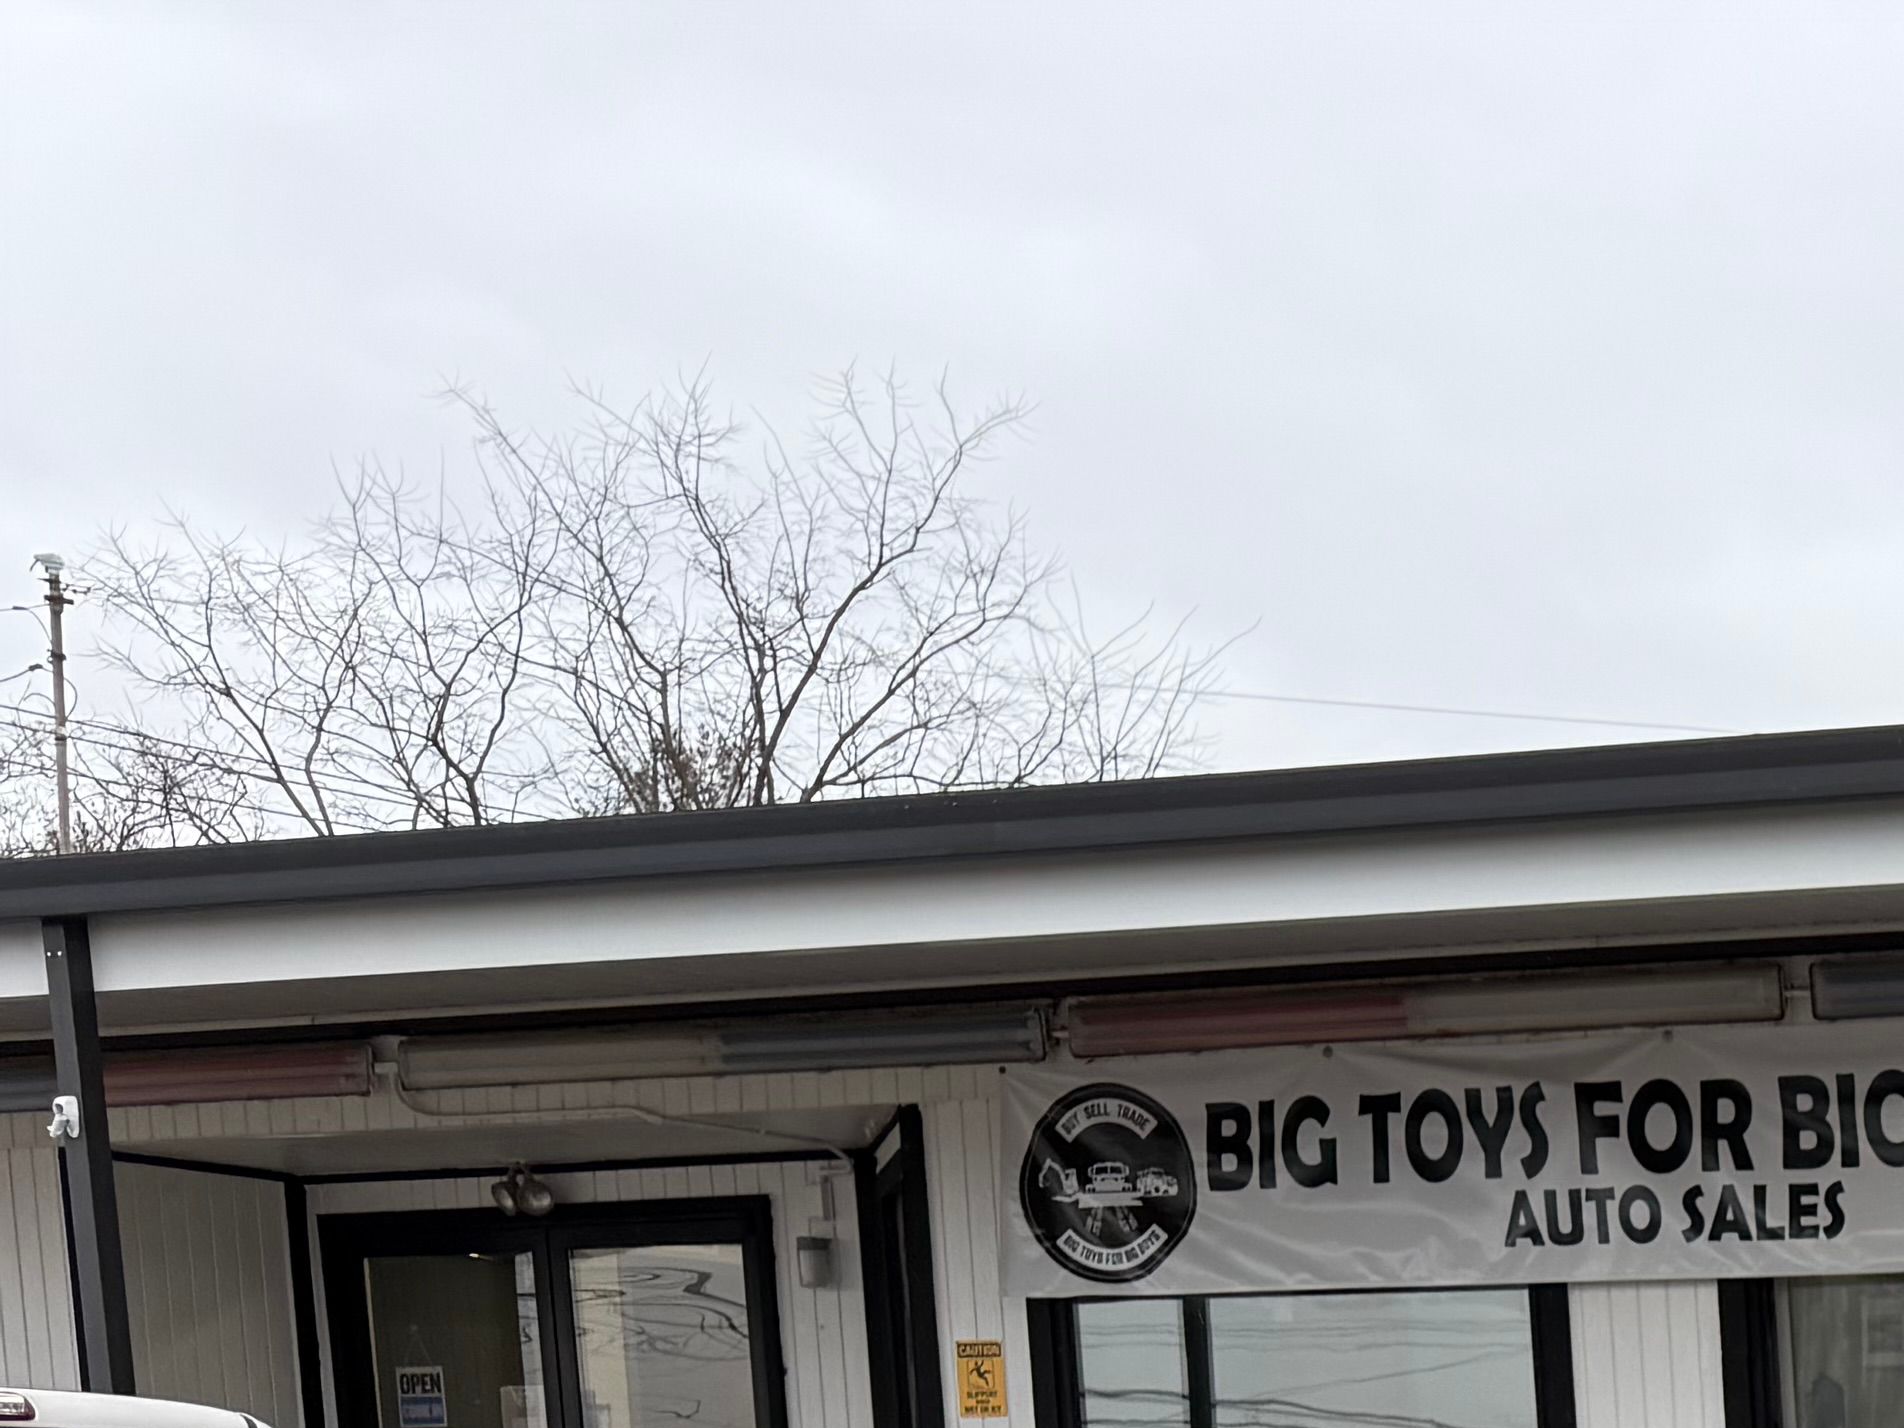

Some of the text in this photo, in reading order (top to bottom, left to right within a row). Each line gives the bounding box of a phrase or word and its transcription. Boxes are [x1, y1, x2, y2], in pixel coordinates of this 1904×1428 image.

[1061, 1102, 1151, 1136] BUY SELL TRADE
[1205, 1095, 1338, 1192] BIG
[1358, 1081, 1550, 1184] TOYS
[1573, 1078, 1755, 1175] FOR
[1504, 1180, 1846, 1248] AUTO SALES
[1063, 1233, 1080, 1254] BIG
[1080, 1245, 1104, 1265] TOYS
[1105, 1250, 1124, 1266] FOR
[1138, 1230, 1162, 1256] BOYS
[960, 1344, 1000, 1357] CAUTION
[400, 1372, 442, 1395] OPEN
